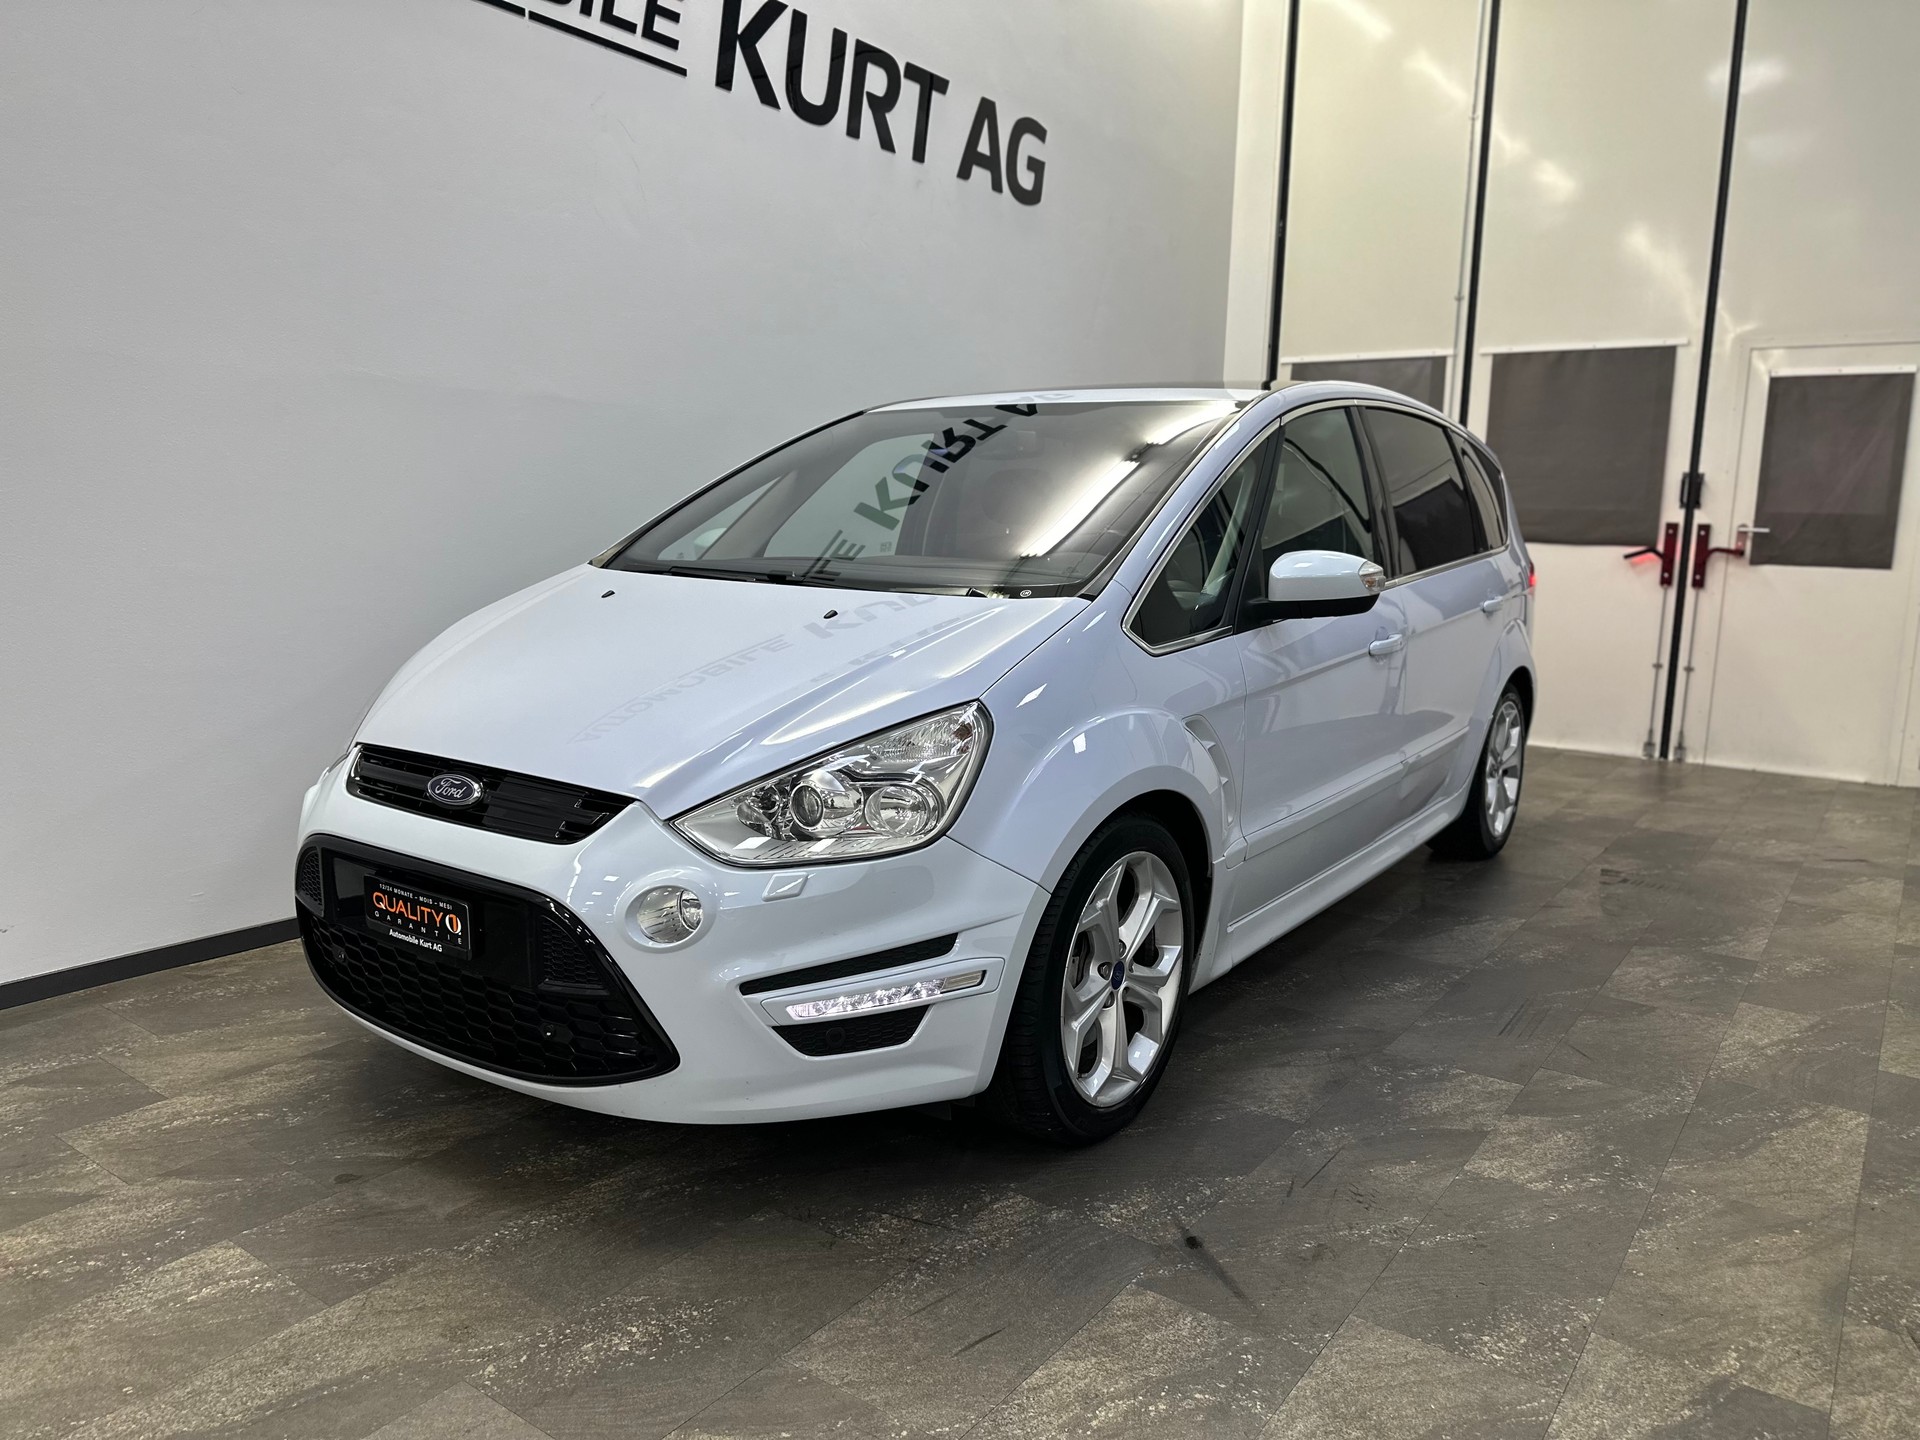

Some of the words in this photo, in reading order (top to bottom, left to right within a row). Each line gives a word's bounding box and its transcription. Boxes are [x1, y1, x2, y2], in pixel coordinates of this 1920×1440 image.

[715, 0, 950, 164] KURT
[956, 96, 1048, 206] AG
[435, 777, 467, 799] Ford
[373, 892, 443, 927] QUALITY
[393, 887, 413, 899] MONATE
[419, 895, 433, 905] MOIS
[439, 901, 453, 910] MESI
[375, 911, 462, 945] GARANTIE
[389, 928, 419, 945] Automobile
[419, 938, 432, 950] Kurt
[432, 942, 443, 953] AG
